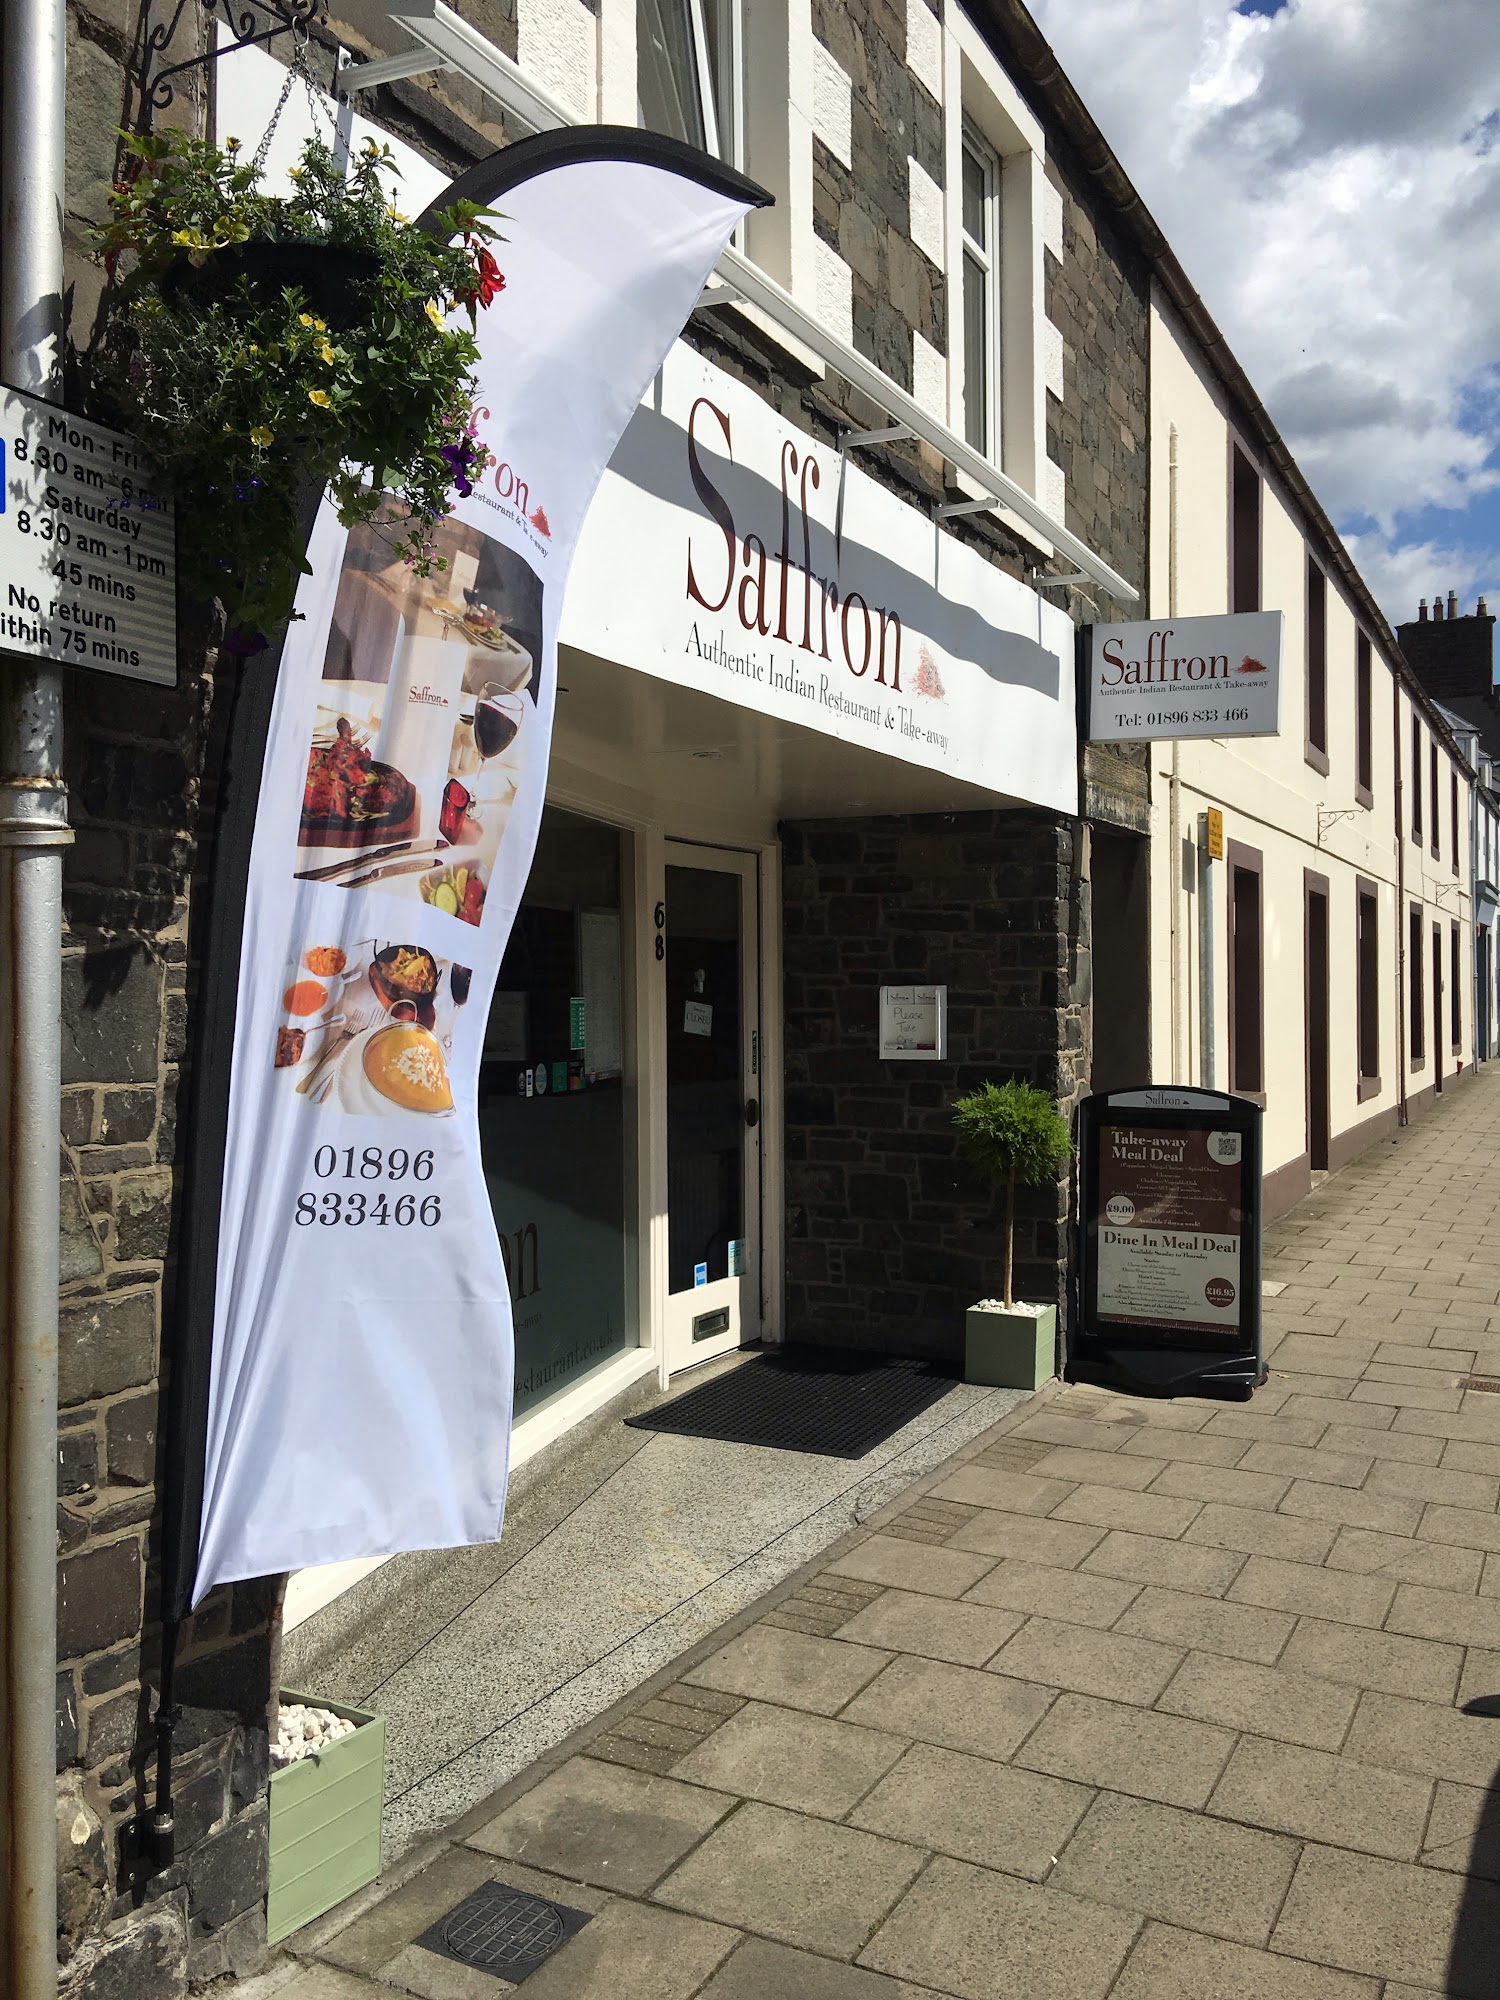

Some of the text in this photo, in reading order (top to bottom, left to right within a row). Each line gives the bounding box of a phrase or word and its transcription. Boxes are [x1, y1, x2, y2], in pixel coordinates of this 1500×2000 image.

[49, 416, 94, 453] Mon
[112, 441, 137, 469] Fri
[14, 438, 67, 475] 8.30
[74, 464, 104, 489] am
[45, 486, 141, 540] Saturday
[471, 490, 515, 521] estaurant
[516, 516, 522, 526] &
[17, 511, 70, 545] 8.30
[76, 534, 106, 558] am
[124, 545, 131, 565] 1
[137, 553, 165, 576] pm
[687, 398, 903, 693] Saffron
[52, 559, 136, 601] 45 mins
[9, 584, 116, 632] No return
[0, 612, 140, 666] ithin 75 mins
[1102, 630, 1230, 686] Saffron
[409, 686, 442, 703] Saffron
[685, 621, 949, 754] Authentic Indian Restaurant & Take-away
[1098, 686, 1137, 697] Authentic
[1139, 685, 1166, 694] Indian
[1169, 683, 1213, 692] Restaurant
[1224, 679, 1268, 690] Take-away
[1115, 707, 1249, 727] Tel: 01896 833 466
[894, 1007, 924, 1020] Please
[896, 1021, 917, 1032] Take
[1145, 1090, 1180, 1106] Saffron
[1111, 1131, 1188, 1149] Take-away
[1112, 1146, 1184, 1163] Meal Deal
[314, 1145, 434, 1181] 01896
[295, 1192, 441, 1226] 833466
[1107, 1204, 1134, 1213] £9.00
[1103, 1231, 1236, 1253] Dine In Meal Deal
[1206, 1287, 1234, 1297] £16.95
